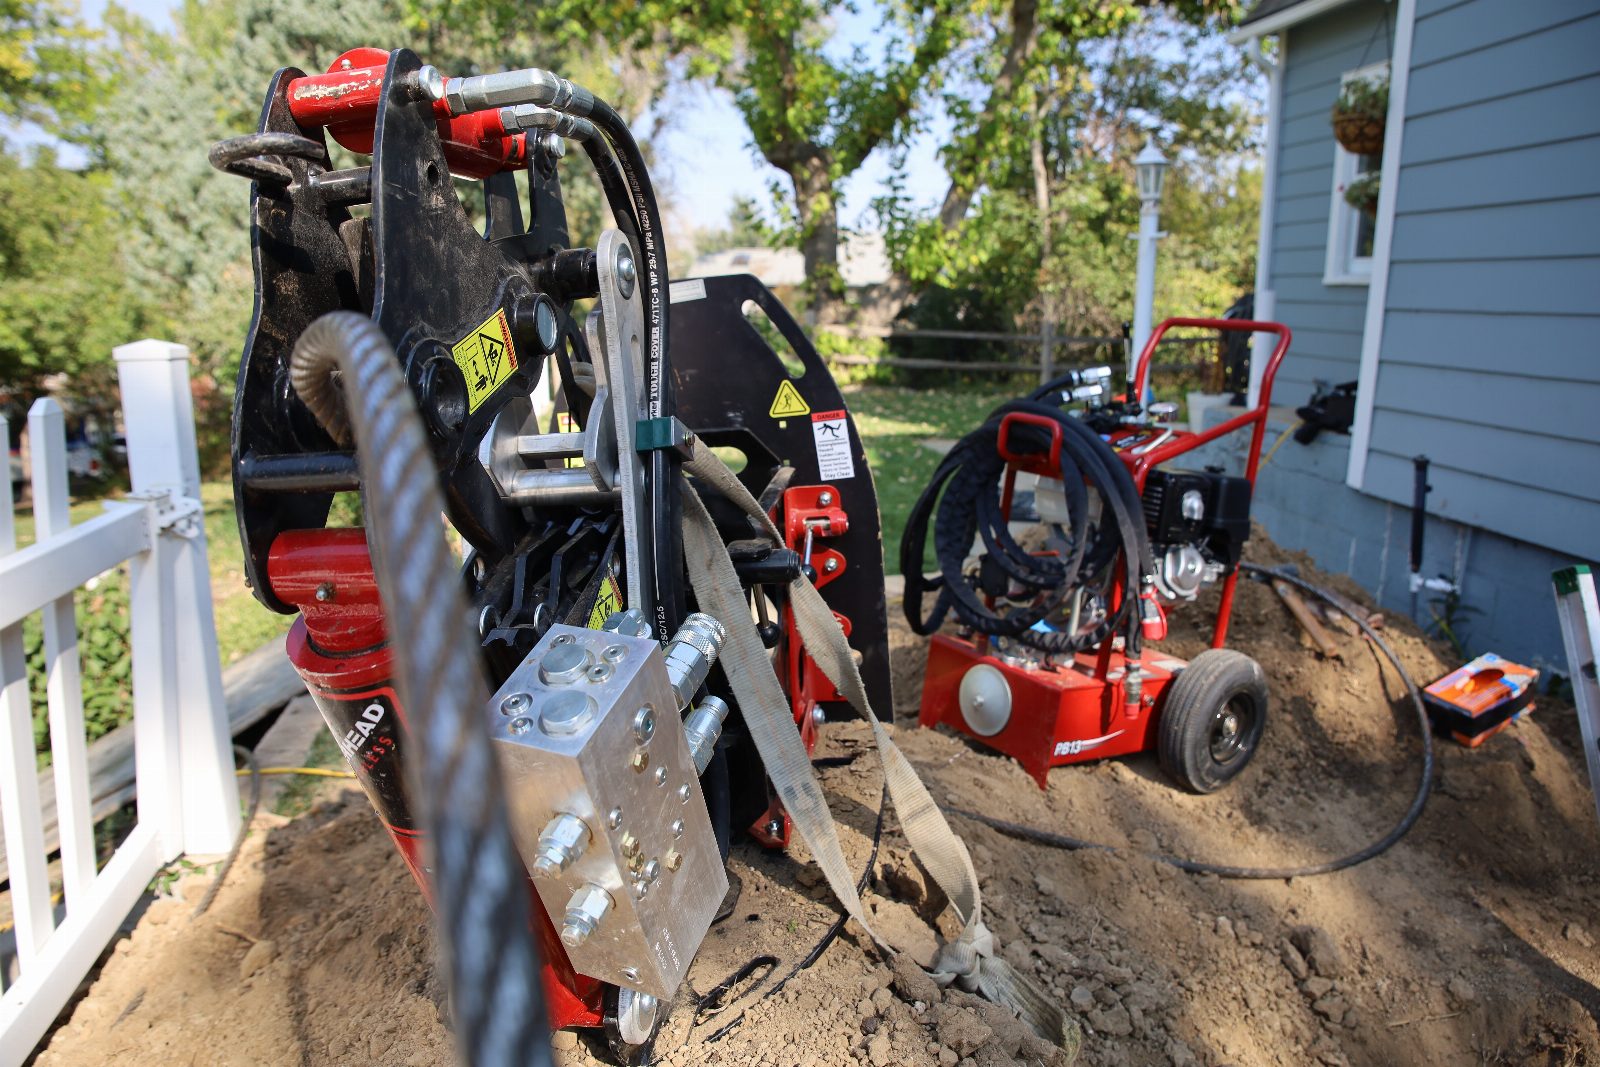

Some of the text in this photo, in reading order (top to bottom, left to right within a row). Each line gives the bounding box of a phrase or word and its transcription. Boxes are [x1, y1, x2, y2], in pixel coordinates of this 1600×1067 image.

[646, 232, 655, 250] MPa
[650, 271, 659, 287] WP
[651, 288, 660, 325] 471TC-8
[650, 326, 660, 359] COVER
[650, 361, 659, 400] TOUGH
[816, 412, 840, 420] DANGER
[361, 736, 393, 771] LESS
